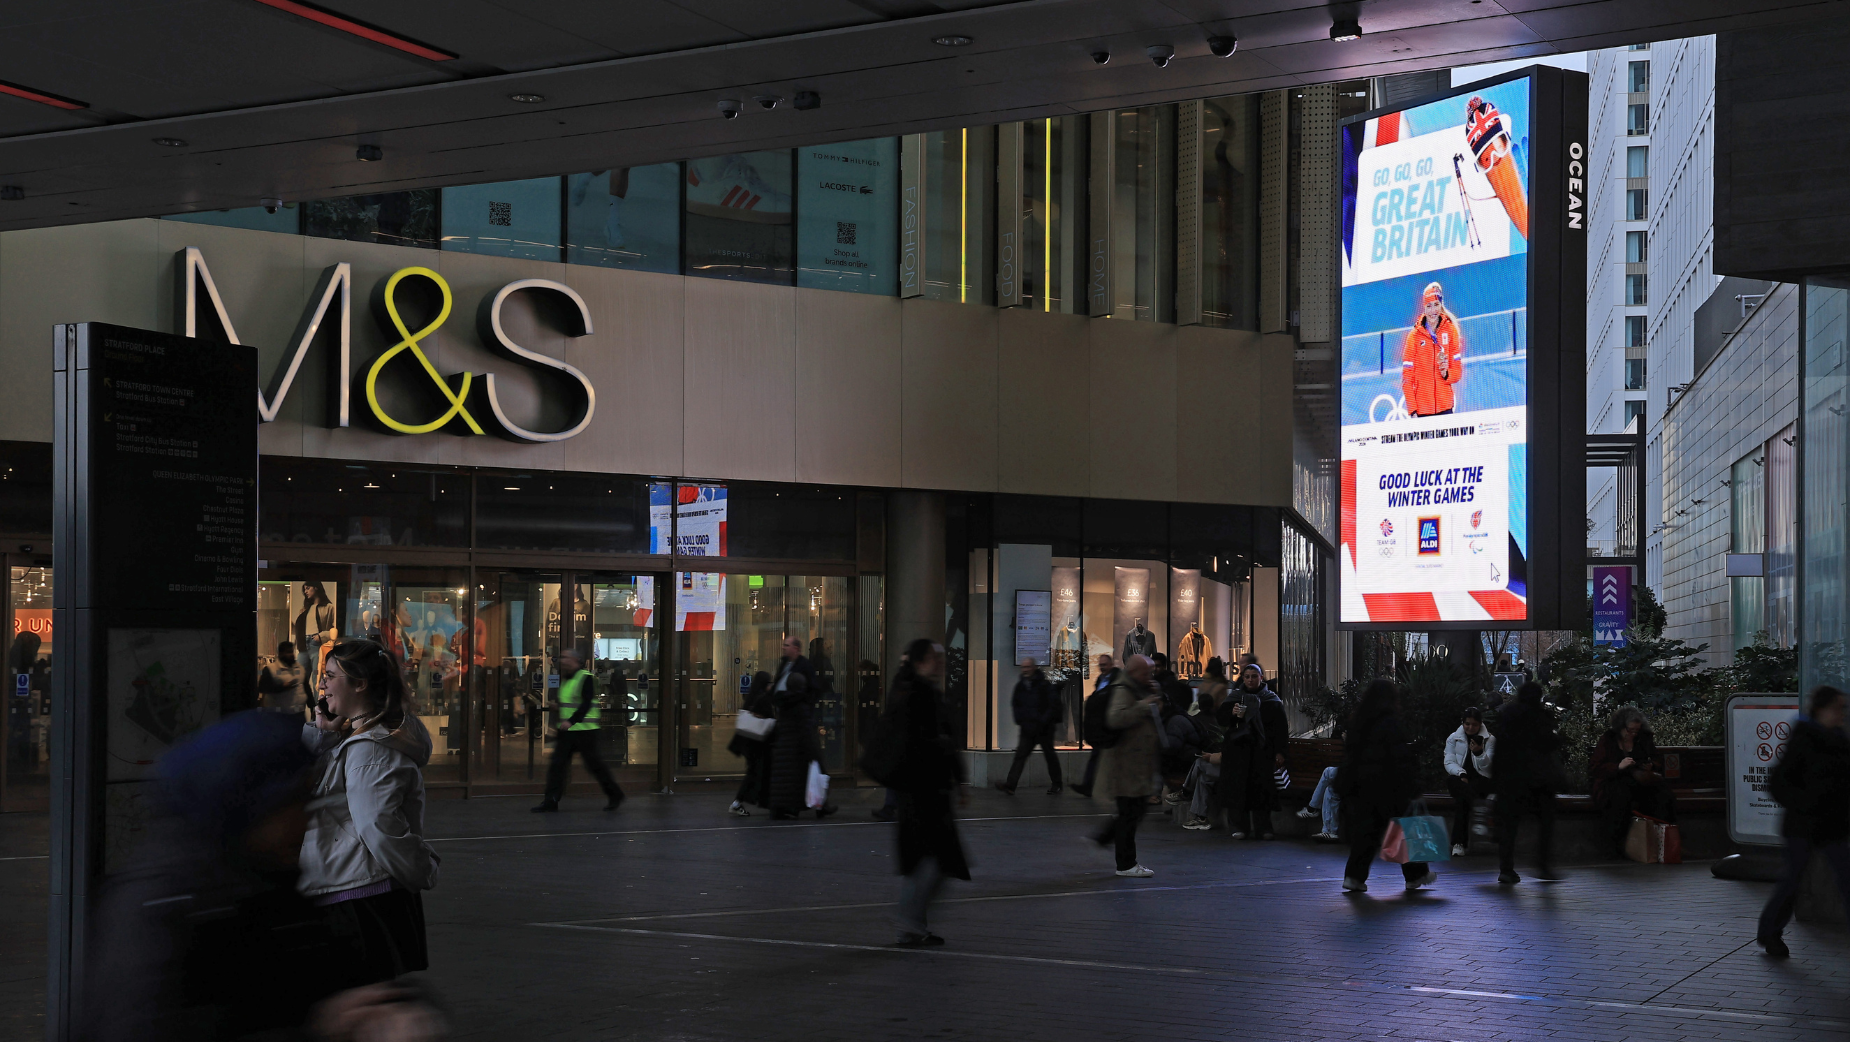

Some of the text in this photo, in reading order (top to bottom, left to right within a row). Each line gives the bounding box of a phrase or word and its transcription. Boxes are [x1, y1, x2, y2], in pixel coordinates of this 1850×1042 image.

[813, 152, 881, 167] TOMMY HILFIGER
[1373, 156, 1434, 187] GO, GO, GO,
[819, 181, 856, 193] LACOSTE
[1568, 141, 1583, 230] OCEAN
[1371, 176, 1453, 228] GREAT
[905, 186, 916, 288] FASHION
[1371, 209, 1470, 264] BRITAIN
[833, 248, 852, 258] Shop
[825, 258, 868, 269] brands online
[1002, 232, 1013, 297] FOOD
[1093, 239, 1105, 307] HOME
[104, 339, 166, 355] STRATFORD PLACE
[174, 245, 597, 445] M&S
[104, 350, 127, 361] Ground
[116, 381, 194, 398] STRATFORD TOWN CENTRE
[116, 391, 179, 405] Stratford Bus Station
[116, 422, 130, 431] Taxi
[116, 433, 192, 448] Stratford City Bus Station
[116, 443, 167, 456] Stratford Station
[153, 470, 244, 485] QUEEN ELIZABETH OLYMPIC PARK
[1379, 466, 1484, 490] GOOD LUCK AT THE
[216, 485, 244, 495] The Street
[226, 496, 244, 505] Casino
[1387, 486, 1475, 508] WINTER GAMES
[203, 504, 244, 515] Chestnut Plaza
[210, 516, 244, 525] Hyatt House
[204, 525, 244, 536] Hyatt Regency
[212, 534, 244, 544] Premier Inn
[1421, 540, 1438, 549] ALDI
[231, 545, 244, 555] Gym
[195, 554, 244, 566] Cinema & Bowling
[214, 575, 244, 584] John Lewis
[181, 584, 244, 594] Stratford International
[1060, 588, 1073, 597] £46
[1127, 588, 1140, 597] £36
[1180, 588, 1192, 597] £40
[211, 594, 244, 606] East Village
[1595, 629, 1624, 641] MAX
[1749, 766, 1755, 774] IN
[1756, 766, 1766, 775] THE
[1743, 775, 1762, 783] PUBLIC
